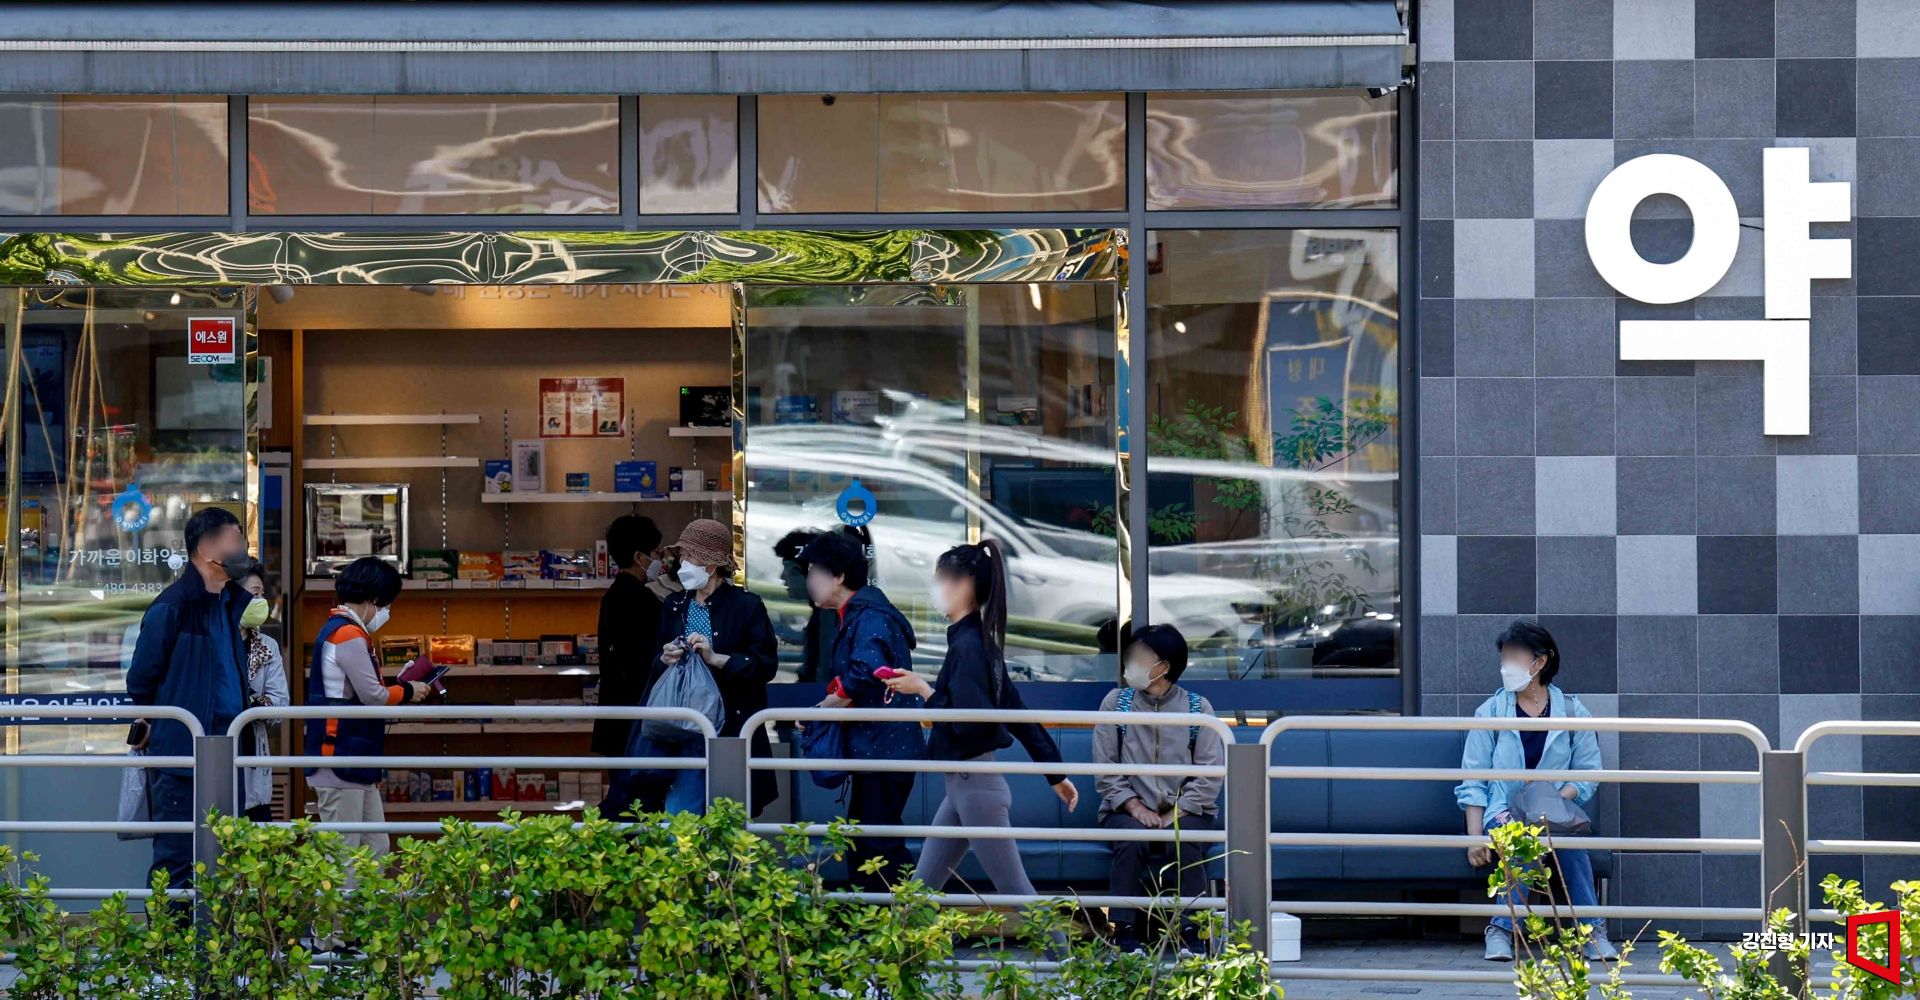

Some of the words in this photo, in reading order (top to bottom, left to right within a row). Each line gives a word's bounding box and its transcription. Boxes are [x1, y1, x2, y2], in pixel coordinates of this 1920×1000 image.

[1585, 147, 1852, 435] 약
[195, 330, 227, 344] 에스원
[191, 355, 220, 363] SECOM
[115, 516, 148, 530] ONNURI
[839, 511, 872, 525] ONNURI
[69, 548, 121, 566] 가까운
